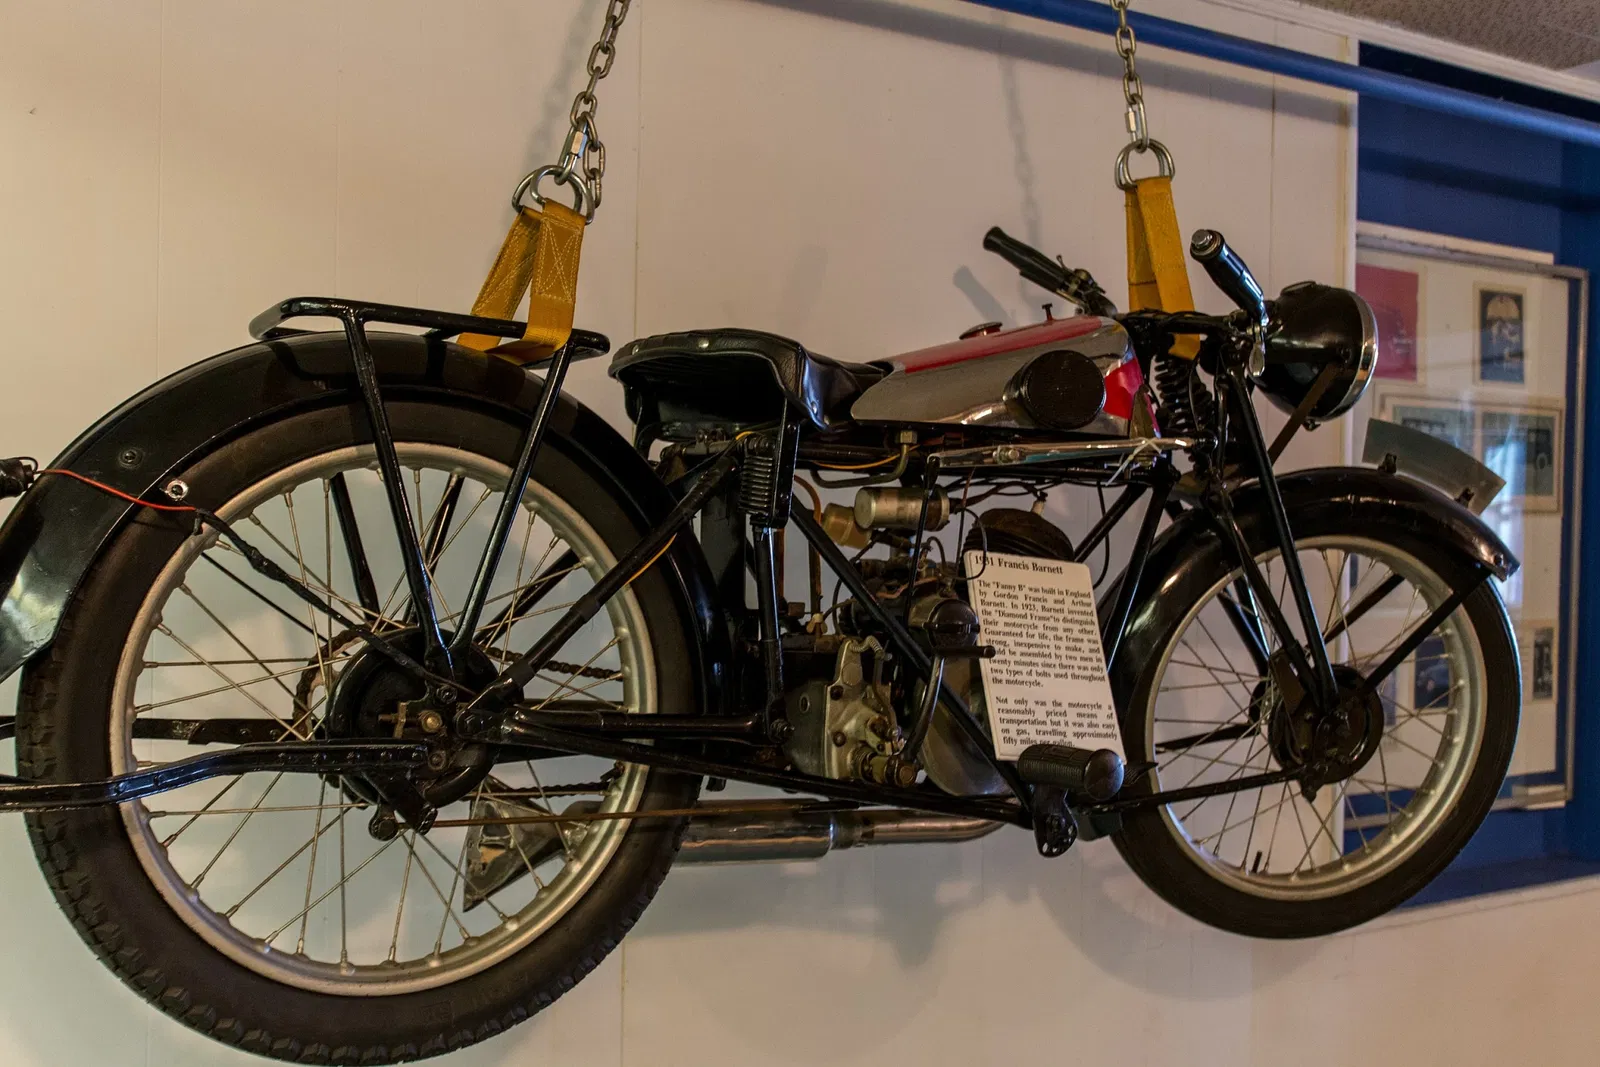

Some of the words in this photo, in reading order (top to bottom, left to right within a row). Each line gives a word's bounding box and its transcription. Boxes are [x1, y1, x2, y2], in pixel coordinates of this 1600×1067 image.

[974, 555, 993, 566] 1931
[997, 558, 1029, 570] Francis
[1031, 562, 1063, 574] Barnett
[978, 589, 987, 598] by
[993, 590, 1018, 599] Gordon
[1023, 594, 1047, 603] Francis
[1070, 599, 1092, 607] Arthur
[1041, 587, 1056, 595] built
[1064, 589, 1091, 600] England
[980, 599, 1007, 608] Barnett.
[1021, 603, 1038, 612] 1923,
[1040, 605, 1064, 613] Barnett
[1067, 608, 1093, 617] invented
[982, 618, 998, 626] their
[1003, 620, 1038, 631] motorcycle
[1042, 624, 1058, 632] from
[1060, 616, 1095, 627] distinguish
[984, 628, 1023, 637] Guaranteed
[1037, 633, 1051, 641] life,
[1065, 635, 1084, 643] frame
[985, 637, 1009, 647] strong,
[1013, 640, 1050, 650] inexpensive
[1064, 644, 1084, 653] make,
[1018, 650, 1051, 658] assembled
[1054, 653, 1062, 661] by
[988, 657, 1011, 666] twenty
[1013, 659, 1039, 667] minutes
[1090, 666, 1104, 674] only
[991, 676, 1003, 684] the
[1004, 677, 1044, 688] motorcycle.
[1005, 667, 1023, 677] types
[1053, 671, 1068, 679] used
[1070, 673, 1106, 683] throughout
[1013, 697, 1028, 706] only
[1067, 701, 1102, 711] motorcycle
[997, 706, 1035, 716] reasonably
[1044, 709, 1067, 718] priced
[998, 716, 1047, 727] transportation
[1002, 736, 1017, 745] fifty
[1019, 737, 1037, 745] miles
[1035, 728, 1067, 738] travelling
[1071, 730, 1118, 741] approximately
